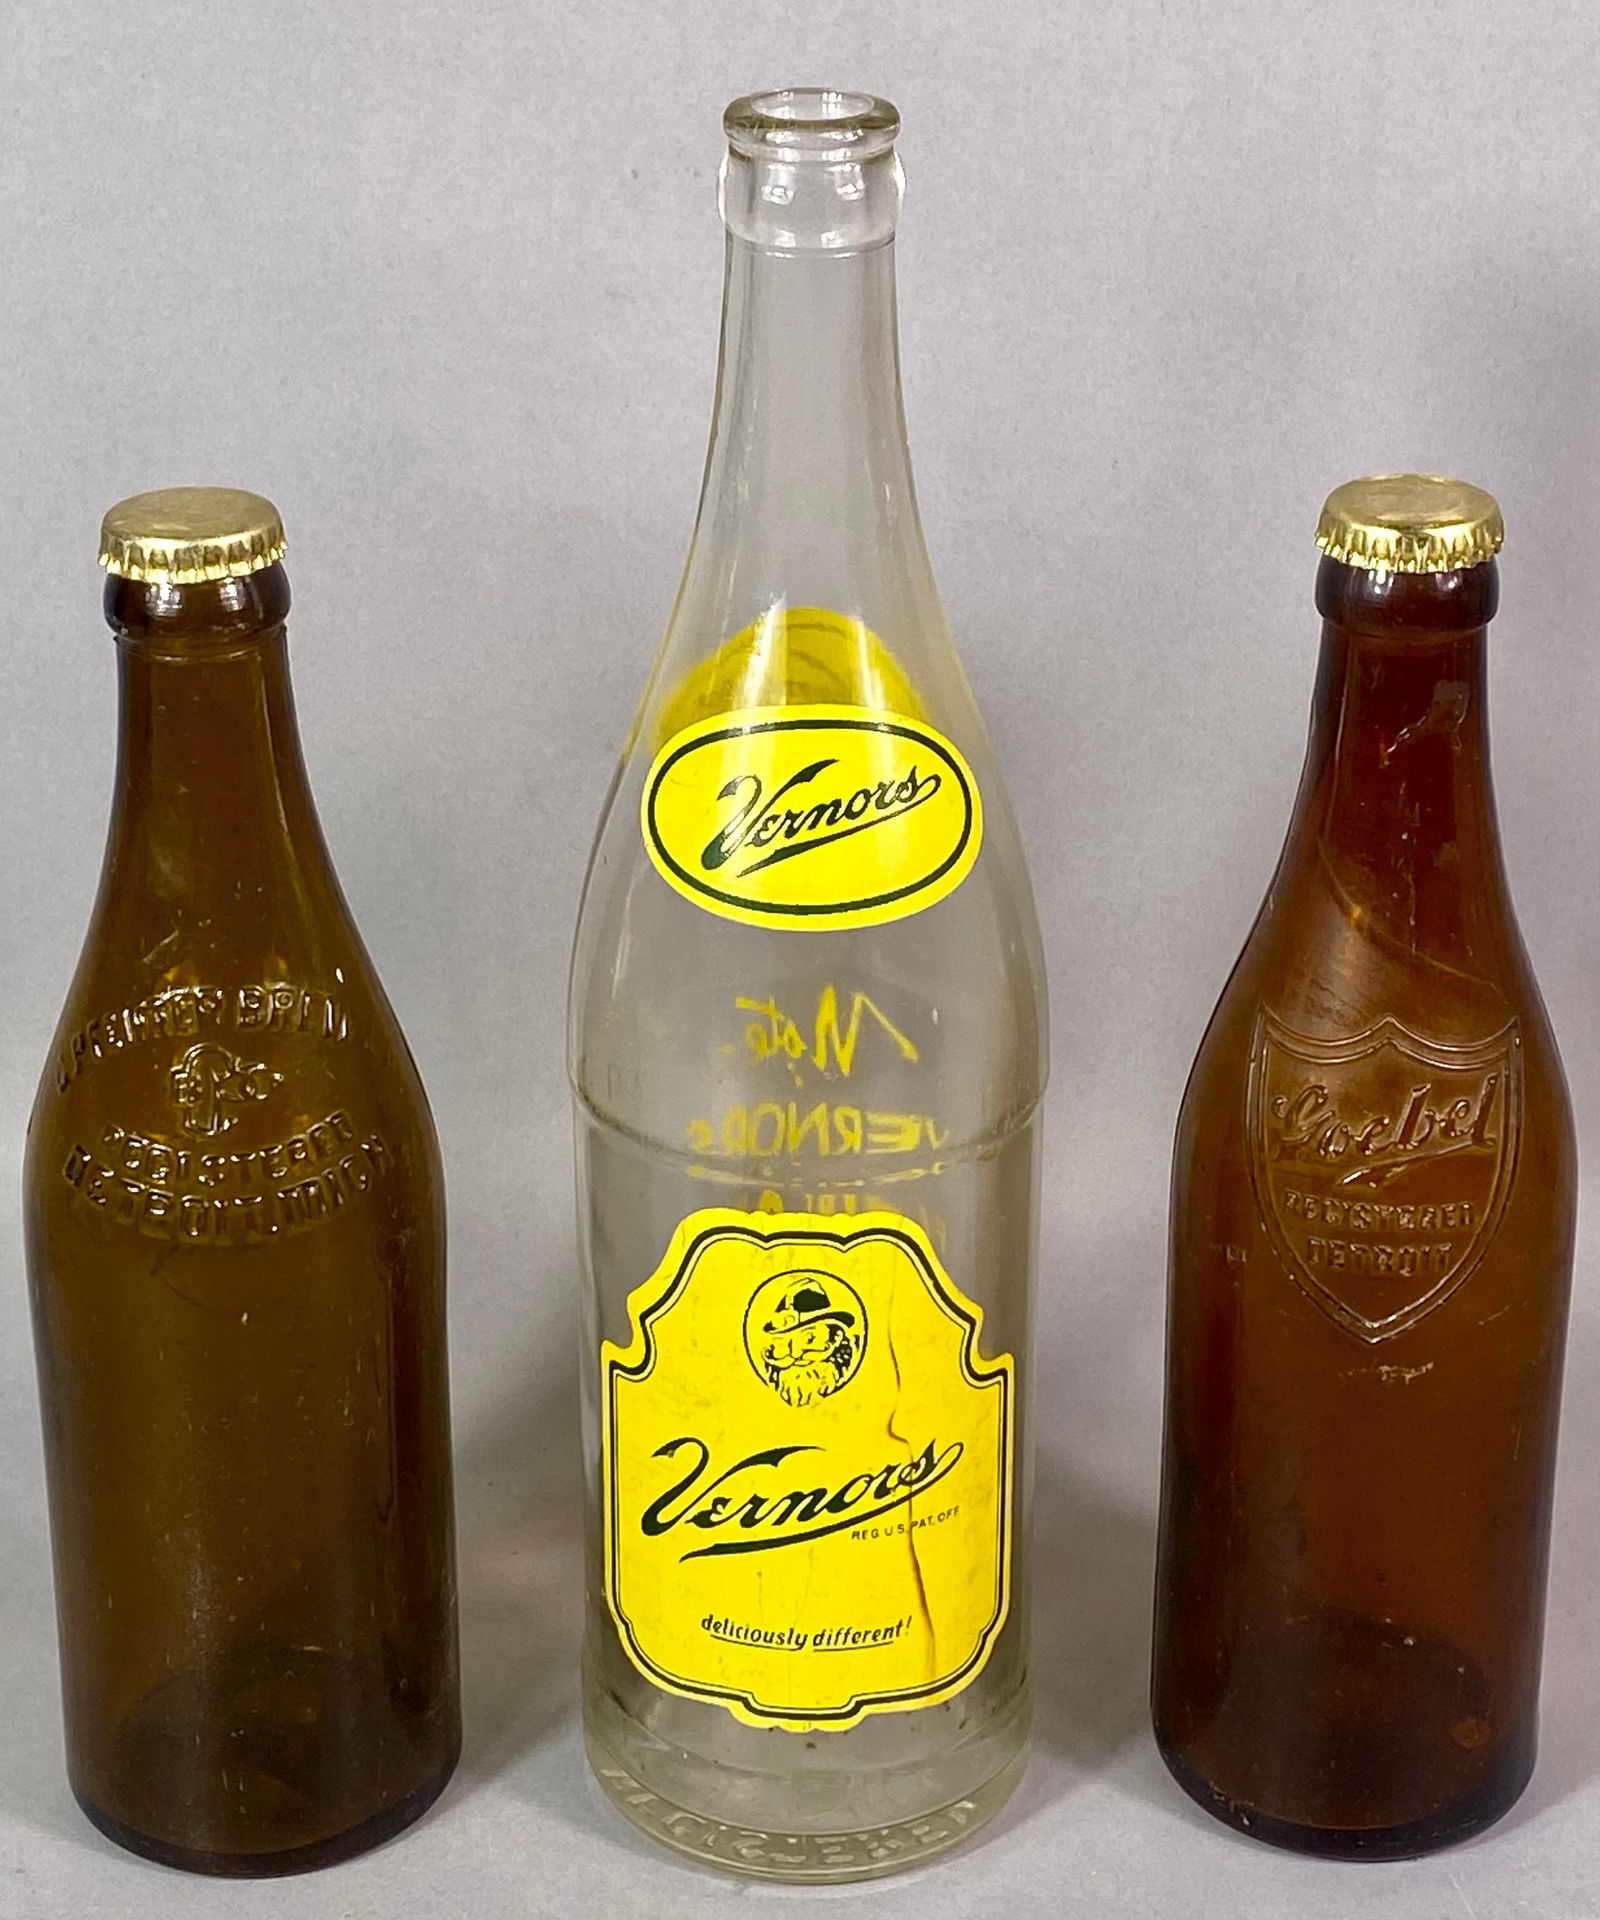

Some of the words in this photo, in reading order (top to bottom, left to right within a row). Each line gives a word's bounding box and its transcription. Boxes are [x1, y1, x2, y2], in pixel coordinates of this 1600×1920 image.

[701, 758, 941, 878] Vernors
[1272, 1072, 1499, 1187] Goebel
[1307, 1236, 1453, 1278] DETROIT
[641, 1436, 965, 1563] Vernors
[701, 1613, 809, 1652] deliciously
[812, 1615, 913, 1648] different!
